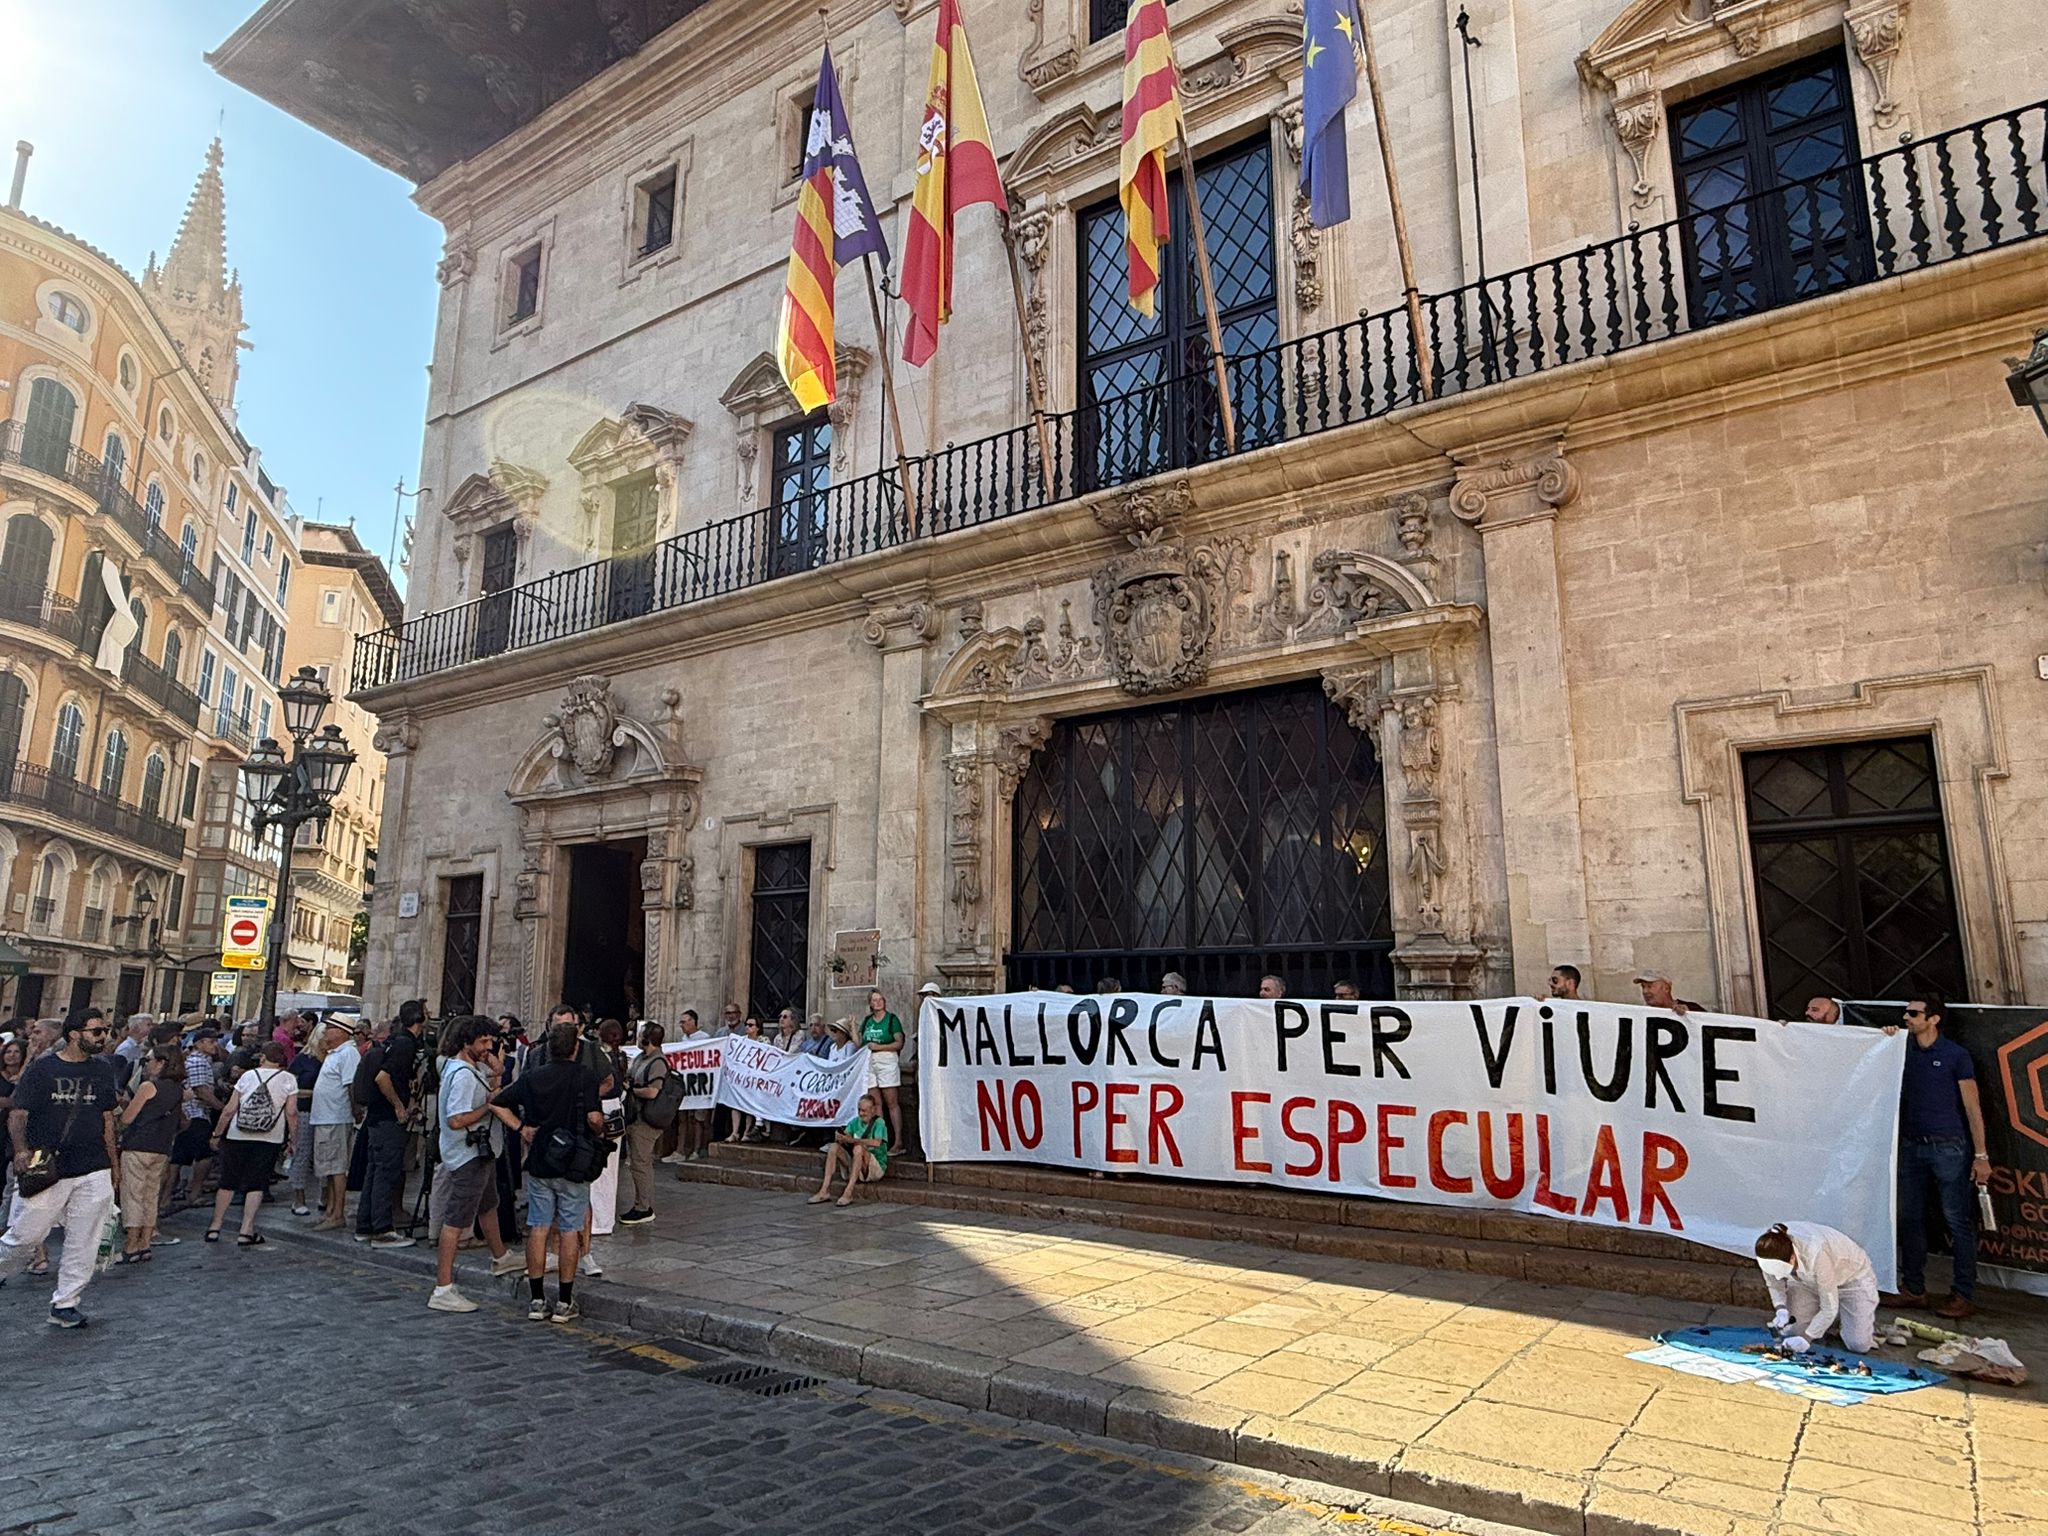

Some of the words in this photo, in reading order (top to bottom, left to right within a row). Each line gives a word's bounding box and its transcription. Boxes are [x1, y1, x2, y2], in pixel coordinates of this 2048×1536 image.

[665, 1049, 721, 1070] SPECULAR
[937, 998, 1227, 1072] MALLORCA
[1274, 1000, 1413, 1080] PER
[976, 1079, 1044, 1152] NO
[1071, 1080, 1184, 1168] PER
[1231, 1090, 1690, 1231] ESPECULAR
